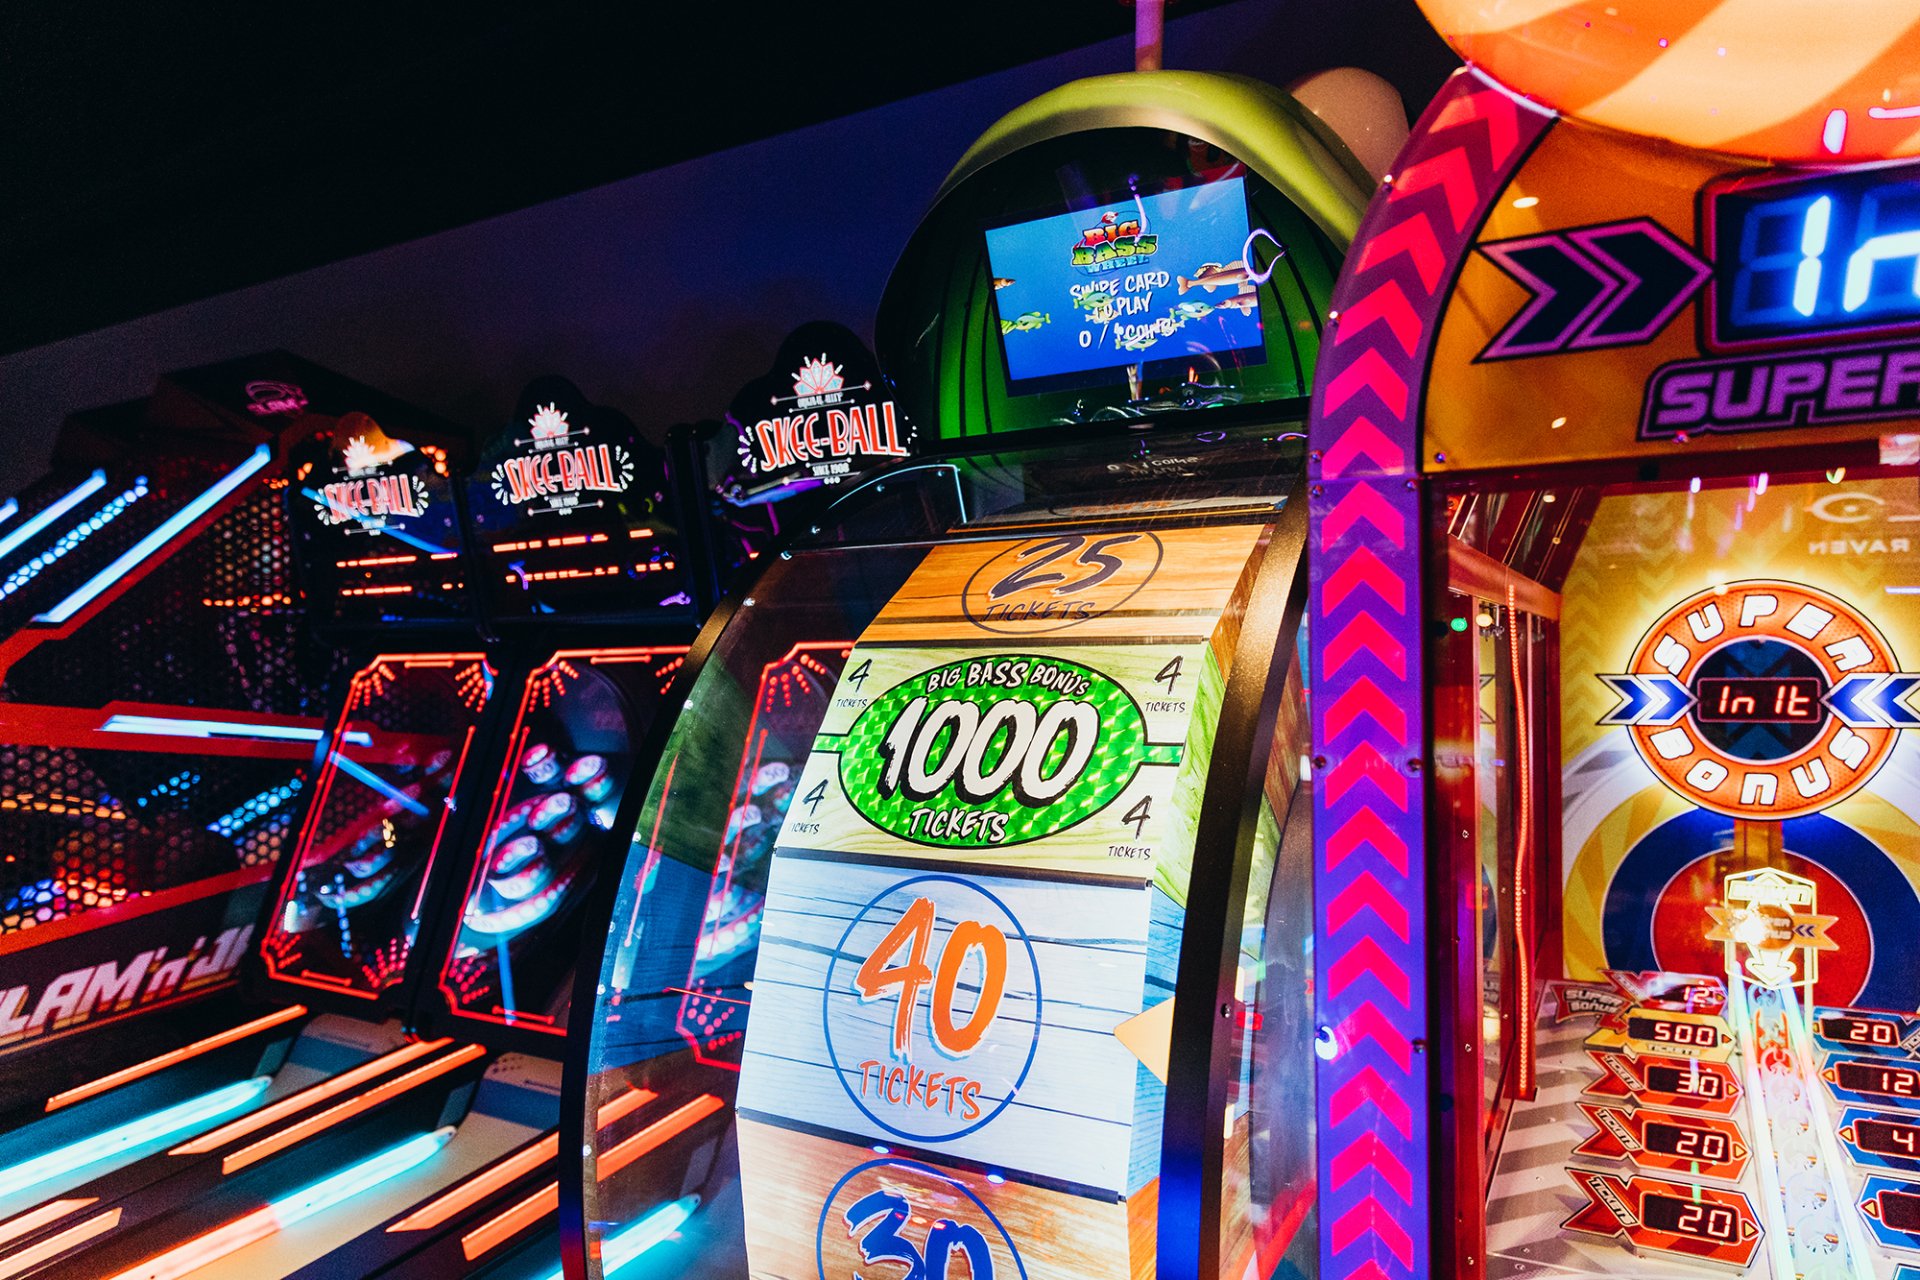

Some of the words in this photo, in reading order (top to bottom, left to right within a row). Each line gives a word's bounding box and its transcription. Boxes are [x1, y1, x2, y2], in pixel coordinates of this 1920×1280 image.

[1083, 219, 1140, 246] BIG
[1072, 235, 1158, 265] BASS
[1085, 255, 1149, 274] WHEEL
[1070, 278, 1120, 300] SWIPE
[1124, 271, 1170, 293] CARD
[1116, 291, 1153, 316] PLAY
[1656, 351, 1920, 425] SUPER
[755, 401, 910, 472] SKEE-BALL
[503, 443, 624, 504] SKEE-BALL
[988, 534, 1145, 601] 25
[983, 600, 1095, 622] TICKETS
[1653, 594, 1874, 676] SUPER
[848, 658, 873, 693] 4
[927, 665, 961, 693] BIG
[967, 661, 1028, 688] BASS
[1029, 662, 1091, 697] BONUS
[1154, 655, 1184, 695] 4
[836, 697, 868, 709] TICKETS
[1144, 701, 1187, 714] TICKETS
[877, 696, 1100, 807] 1000
[1650, 726, 1870, 806] BONUS
[802, 779, 829, 817] 4
[787, 822, 820, 835] ICKETS
[909, 807, 1009, 843] TICKETS
[1121, 795, 1152, 840] 4
[1108, 844, 1151, 860] TICKETS
[851, 896, 1008, 1062] 40
[1565, 990, 1624, 1008] SUPER
[1683, 986, 1710, 1003] 12
[1655, 1022, 1715, 1046] 500
[1850, 1022, 1891, 1043] 20
[858, 1060, 982, 1121] TICKETS
[1676, 1072, 1719, 1096] 30
[1882, 1072, 1914, 1094] 12
[1675, 1130, 1724, 1160] 20
[1892, 1129, 1914, 1153] 4
[1677, 1205, 1732, 1239] 20
